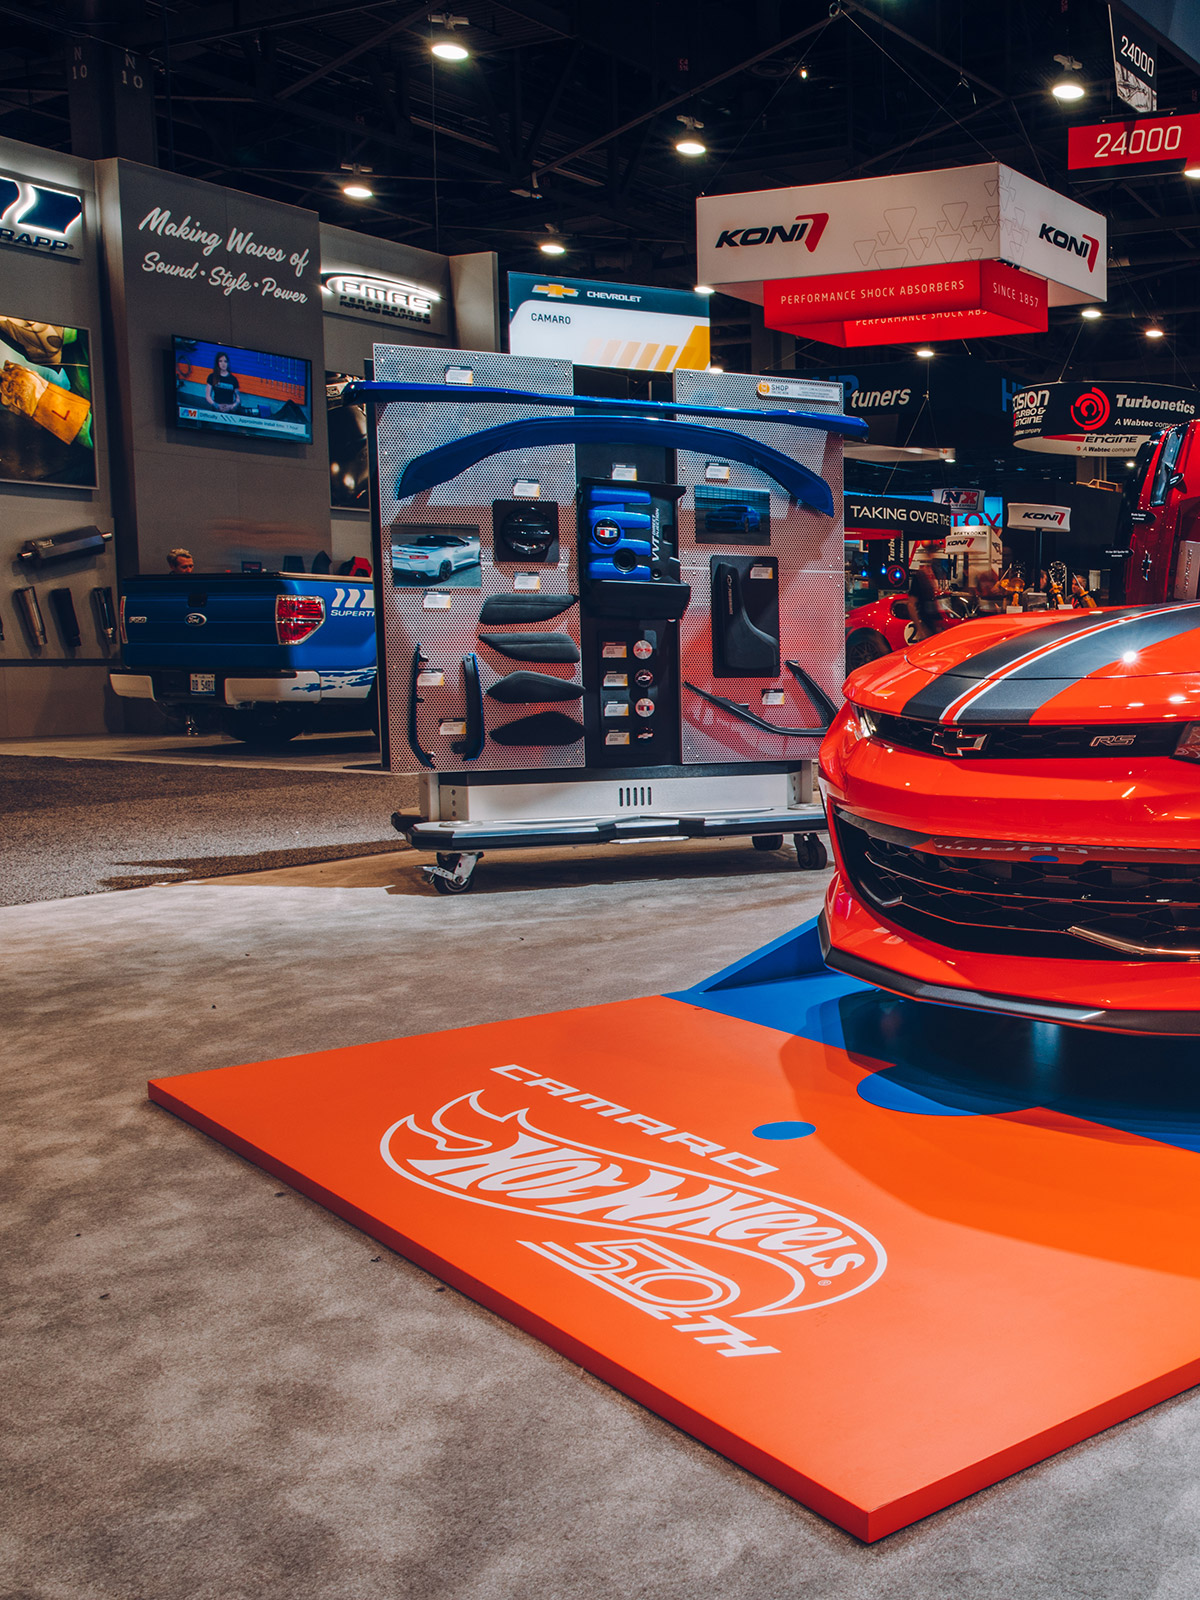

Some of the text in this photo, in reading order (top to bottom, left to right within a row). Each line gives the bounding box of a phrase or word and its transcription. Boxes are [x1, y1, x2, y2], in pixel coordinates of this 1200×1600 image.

[1121, 35, 1155, 77] 24000
[1094, 125, 1182, 158] 24000
[138, 206, 309, 277] Making Waves of
[715, 223, 808, 248] KONI
[1039, 223, 1089, 258] KONI
[141, 251, 308, 304] Sound Style Power
[587, 291, 642, 303] CHEVROLET
[780, 279, 965, 305] PERFORMANCE SHOCK ABSORBERS
[993, 282, 1039, 308] SINCE 1857
[531, 313, 571, 325] CAMARO
[851, 388, 912, 408] tuners
[1116, 394, 1196, 415] Turbonetics
[1115, 418, 1121, 426] A
[1123, 418, 1153, 427] Wabtec
[943, 491, 978, 504] NX
[850, 505, 951, 527] TAKING OVER THE
[1022, 512, 1059, 521] KONI
[1089, 734, 1136, 747] RS
[489, 1064, 780, 1177] CAMARO
